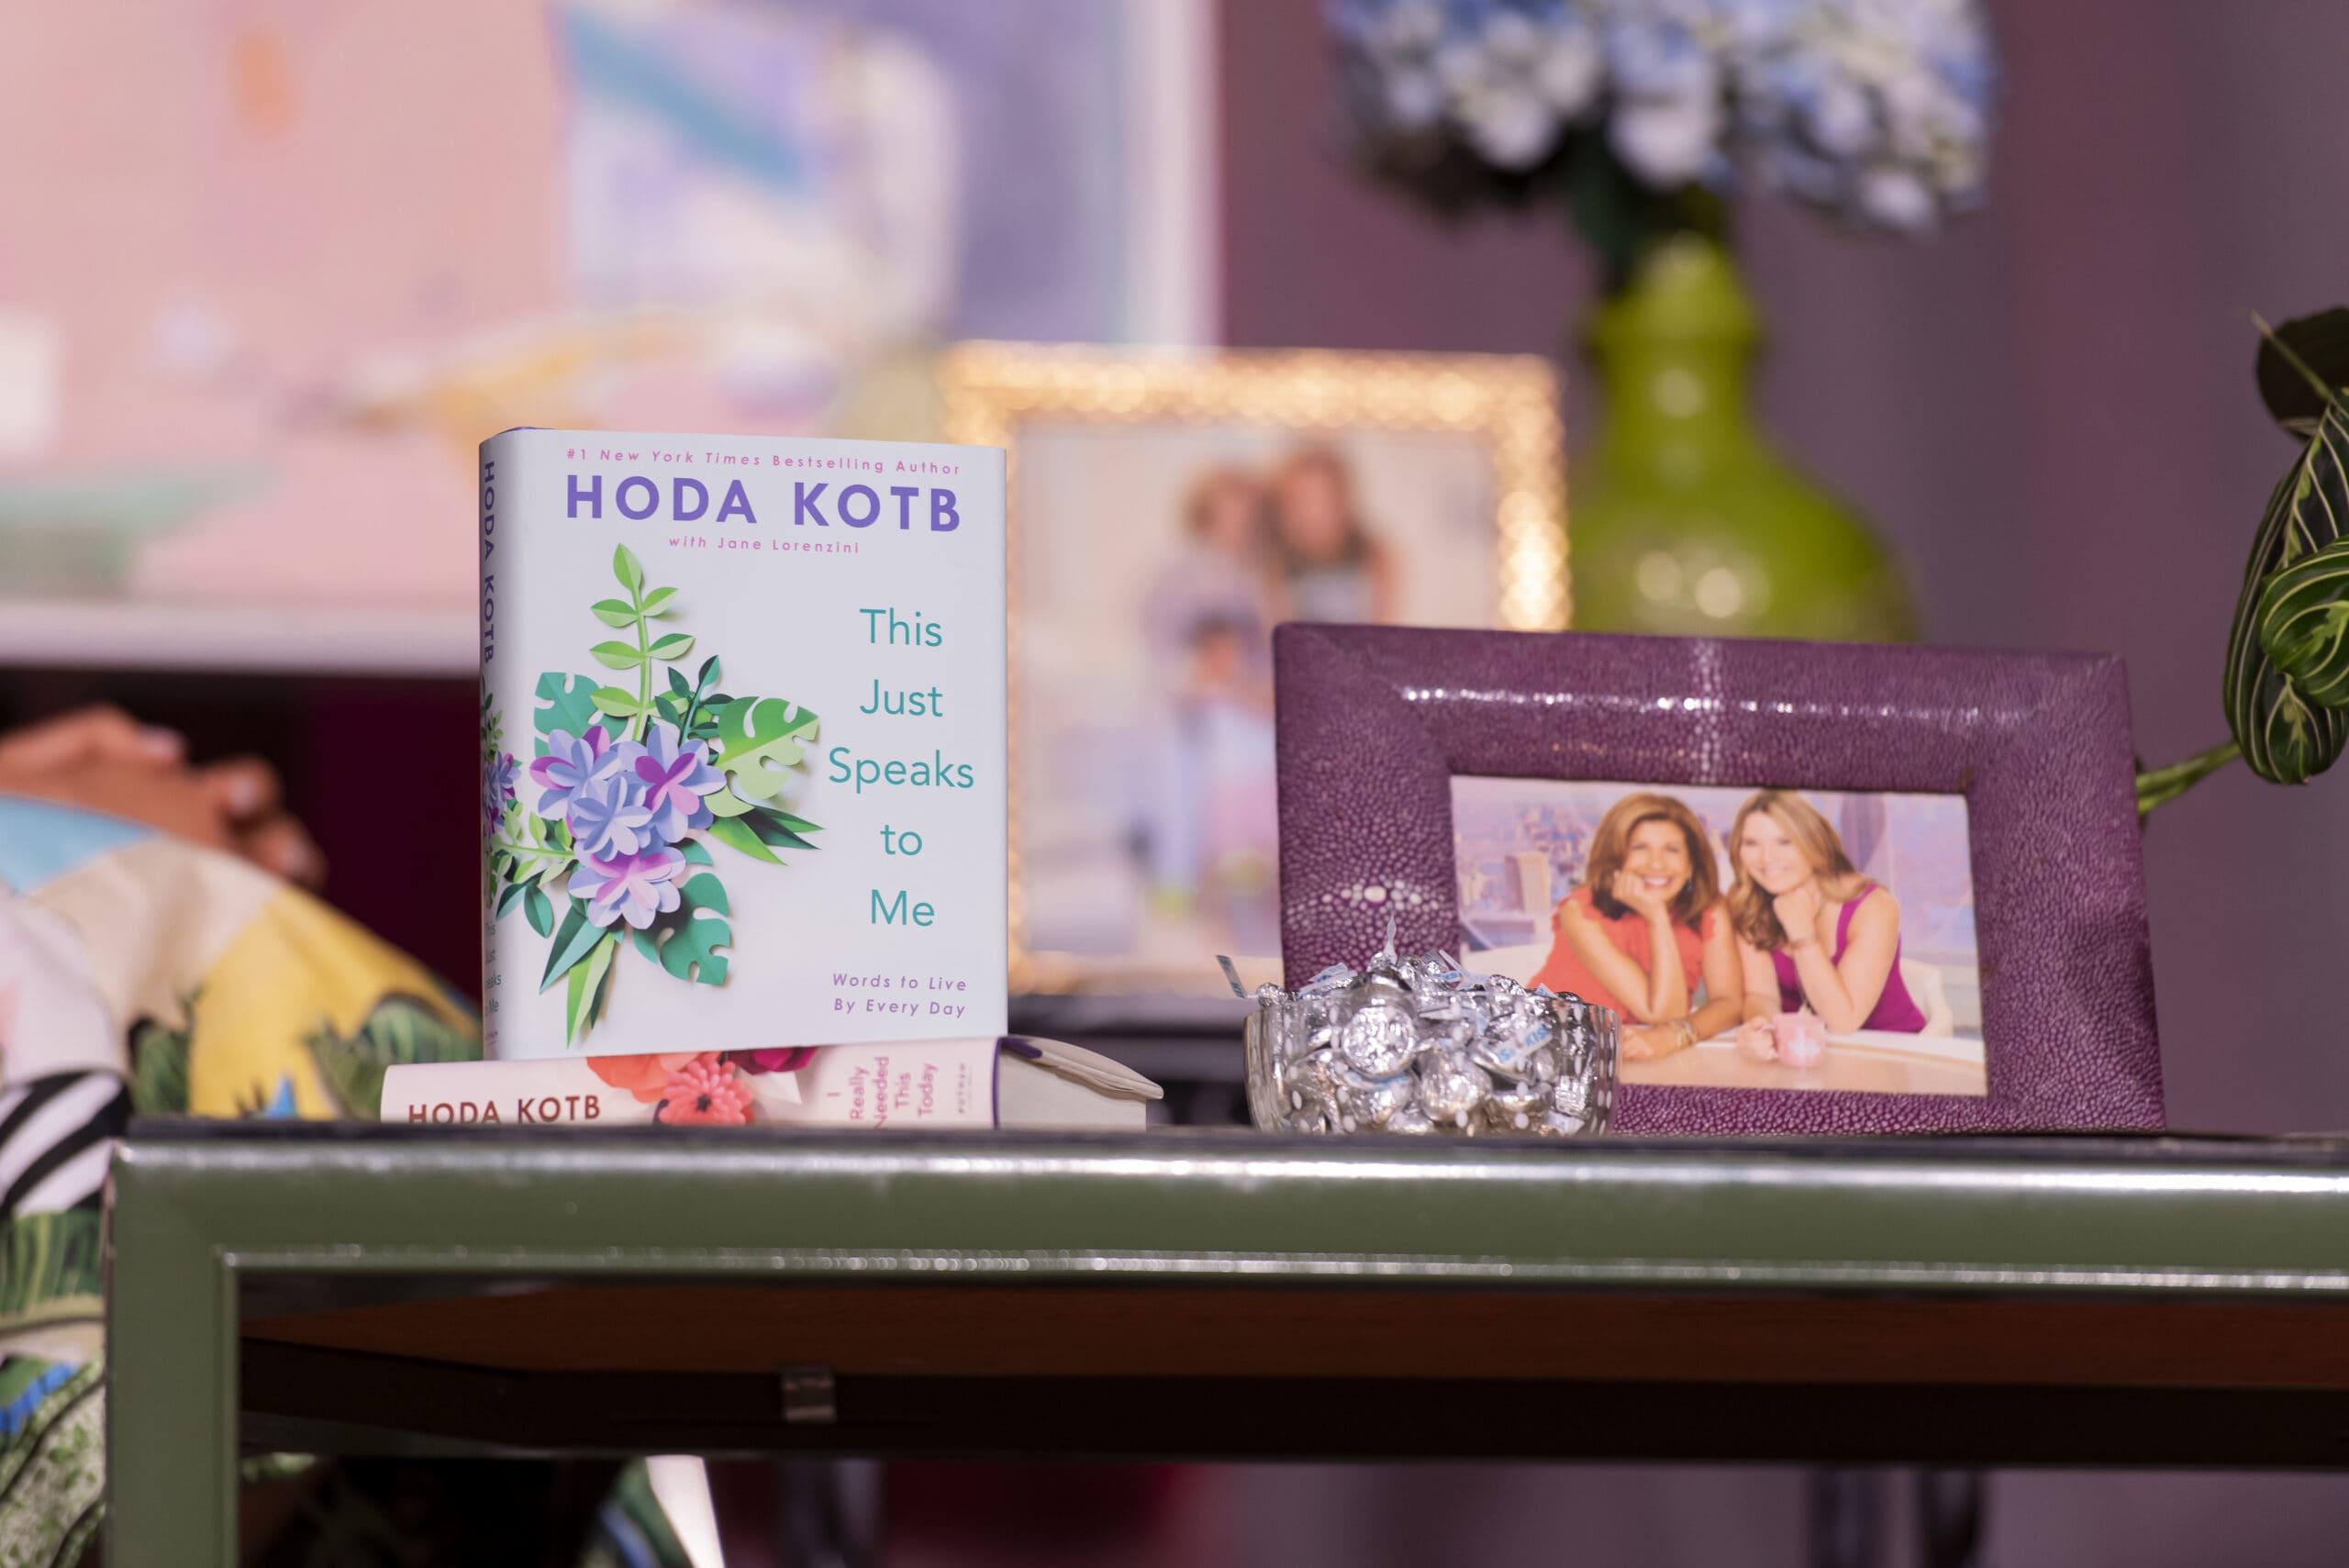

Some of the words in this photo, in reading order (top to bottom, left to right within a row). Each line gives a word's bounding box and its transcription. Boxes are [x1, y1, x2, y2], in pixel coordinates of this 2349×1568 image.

[566, 449, 585, 460] #1
[600, 450, 640, 462] New
[652, 450, 694, 462] York
[707, 452, 760, 465] Times
[773, 455, 884, 473] Bestselling
[896, 461, 960, 474] Author
[484, 461, 495, 562] HODA
[567, 474, 758, 524] HODA
[795, 482, 960, 532] KOTB
[669, 536, 707, 548] with
[718, 537, 762, 550] Jane
[773, 539, 859, 552] Lorenzini
[484, 574, 495, 663] KOTB
[859, 607, 943, 648] This
[859, 679, 943, 717] Just
[828, 747, 974, 795] Speaks
[880, 825, 923, 857] to
[871, 888, 935, 927] Me
[833, 973, 891, 987] Words
[901, 975, 918, 989] to
[929, 977, 967, 991] Live
[834, 997, 855, 1015] By
[866, 999, 919, 1017] Every
[929, 1002, 966, 1018] Day
[850, 1066, 870, 1120] Really
[874, 1056, 890, 1129] Needed
[895, 1072, 911, 1108] This
[918, 1062, 939, 1117] Today
[408, 1101, 501, 1124] HODA
[518, 1095, 601, 1123] KOTB
